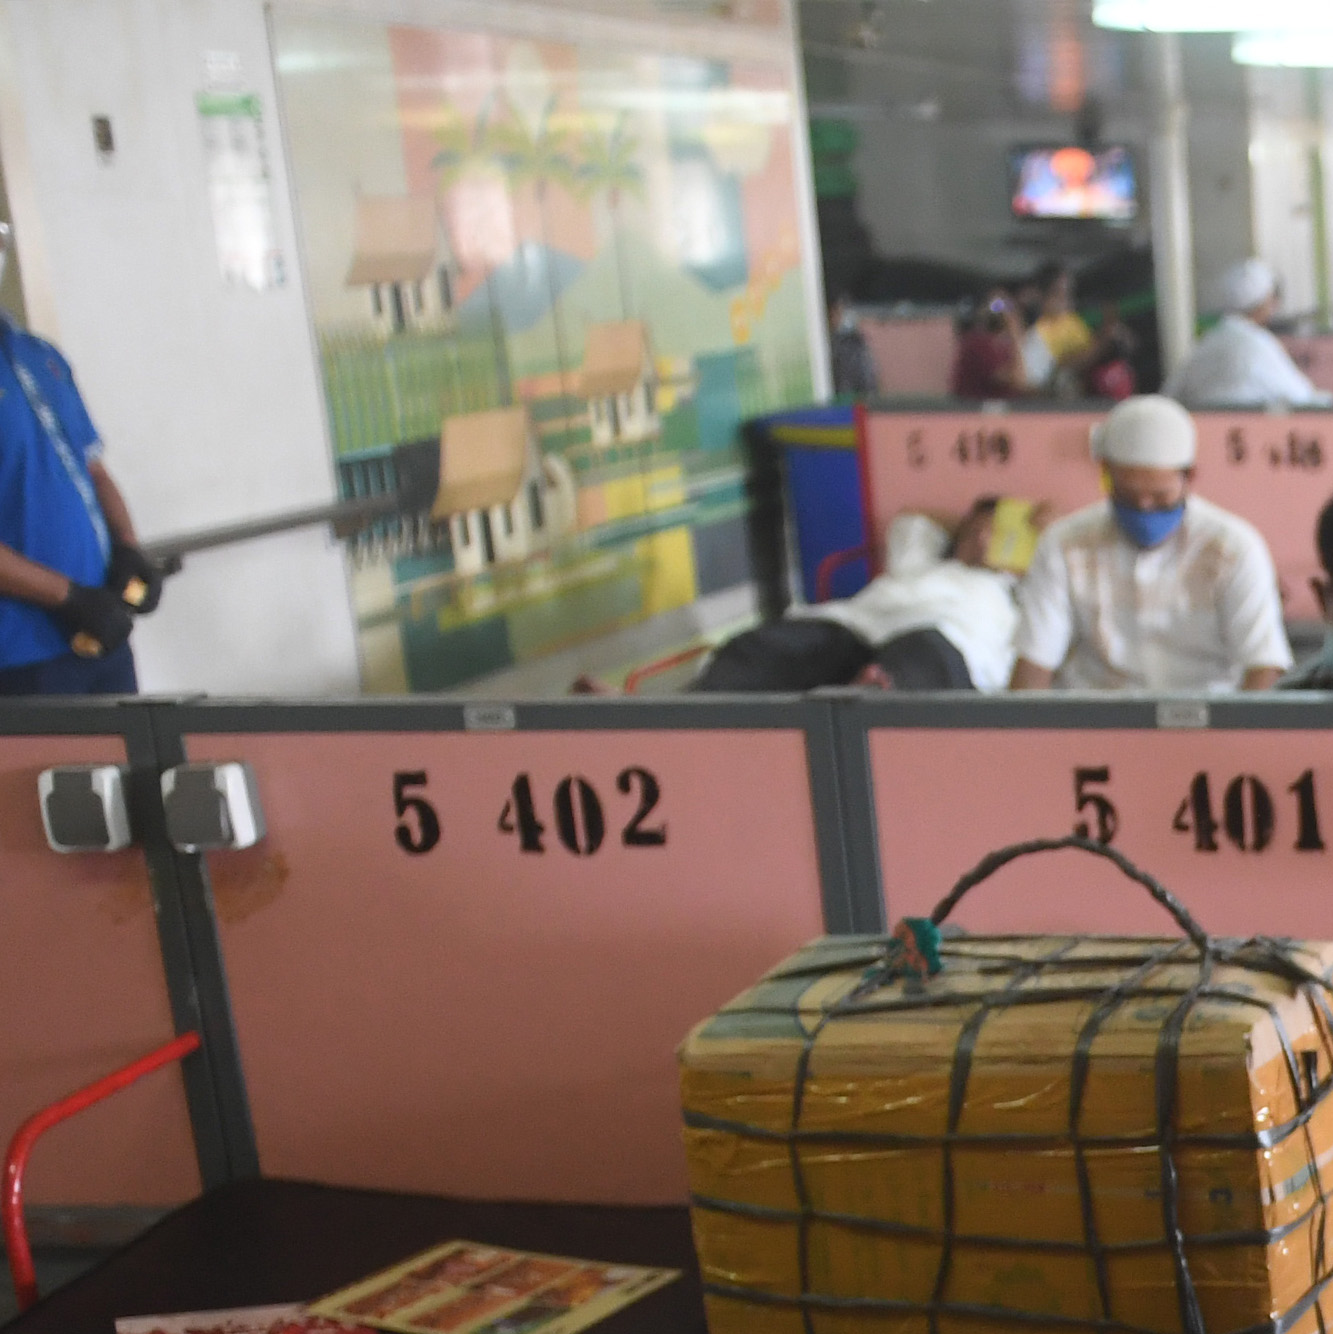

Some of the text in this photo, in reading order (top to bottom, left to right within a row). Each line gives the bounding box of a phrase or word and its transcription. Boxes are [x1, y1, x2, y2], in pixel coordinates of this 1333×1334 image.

[393, 765, 667, 857] 5 402
[1073, 765, 1326, 854] 5 401
